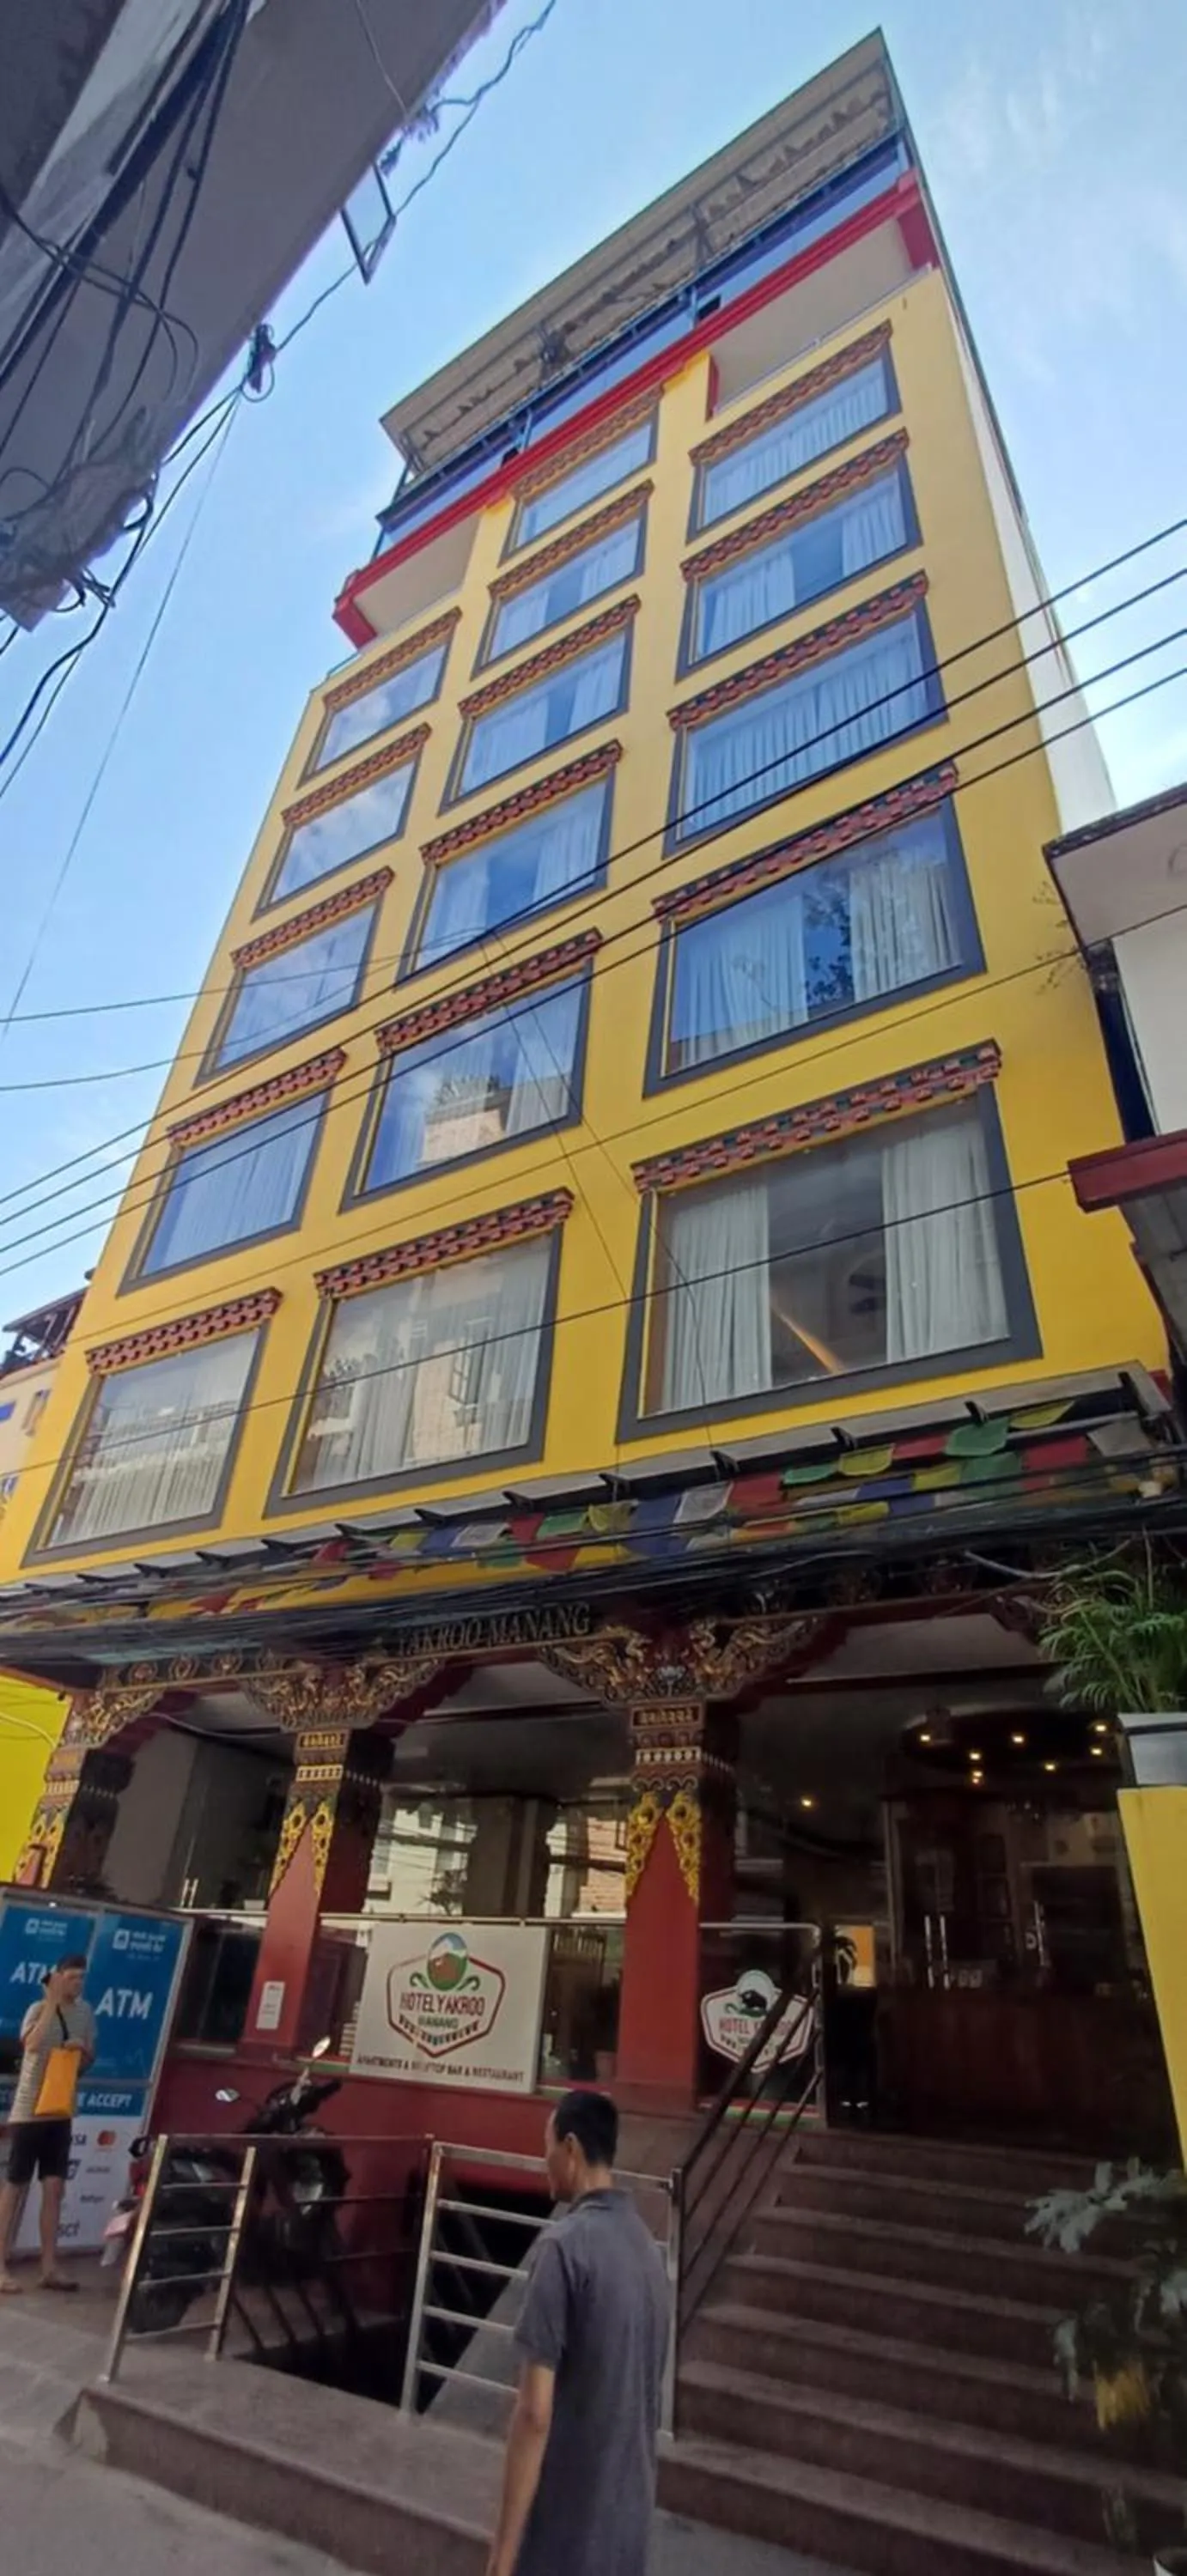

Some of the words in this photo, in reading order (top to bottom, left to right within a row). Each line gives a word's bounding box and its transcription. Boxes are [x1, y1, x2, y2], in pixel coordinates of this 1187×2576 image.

[484, 1601, 590, 1648] MANANG
[94, 1987, 153, 2020] ATM
[400, 1991, 435, 2013] HOTEL
[436, 1993, 485, 2017] YAKROO
[417, 2015, 460, 2029] MANANG
[720, 2018, 752, 2035] HOTEL
[447, 2063, 464, 2076] BAR
[473, 2066, 525, 2083] RESTAURANT
[87, 2093, 133, 2109] ACCEPT
